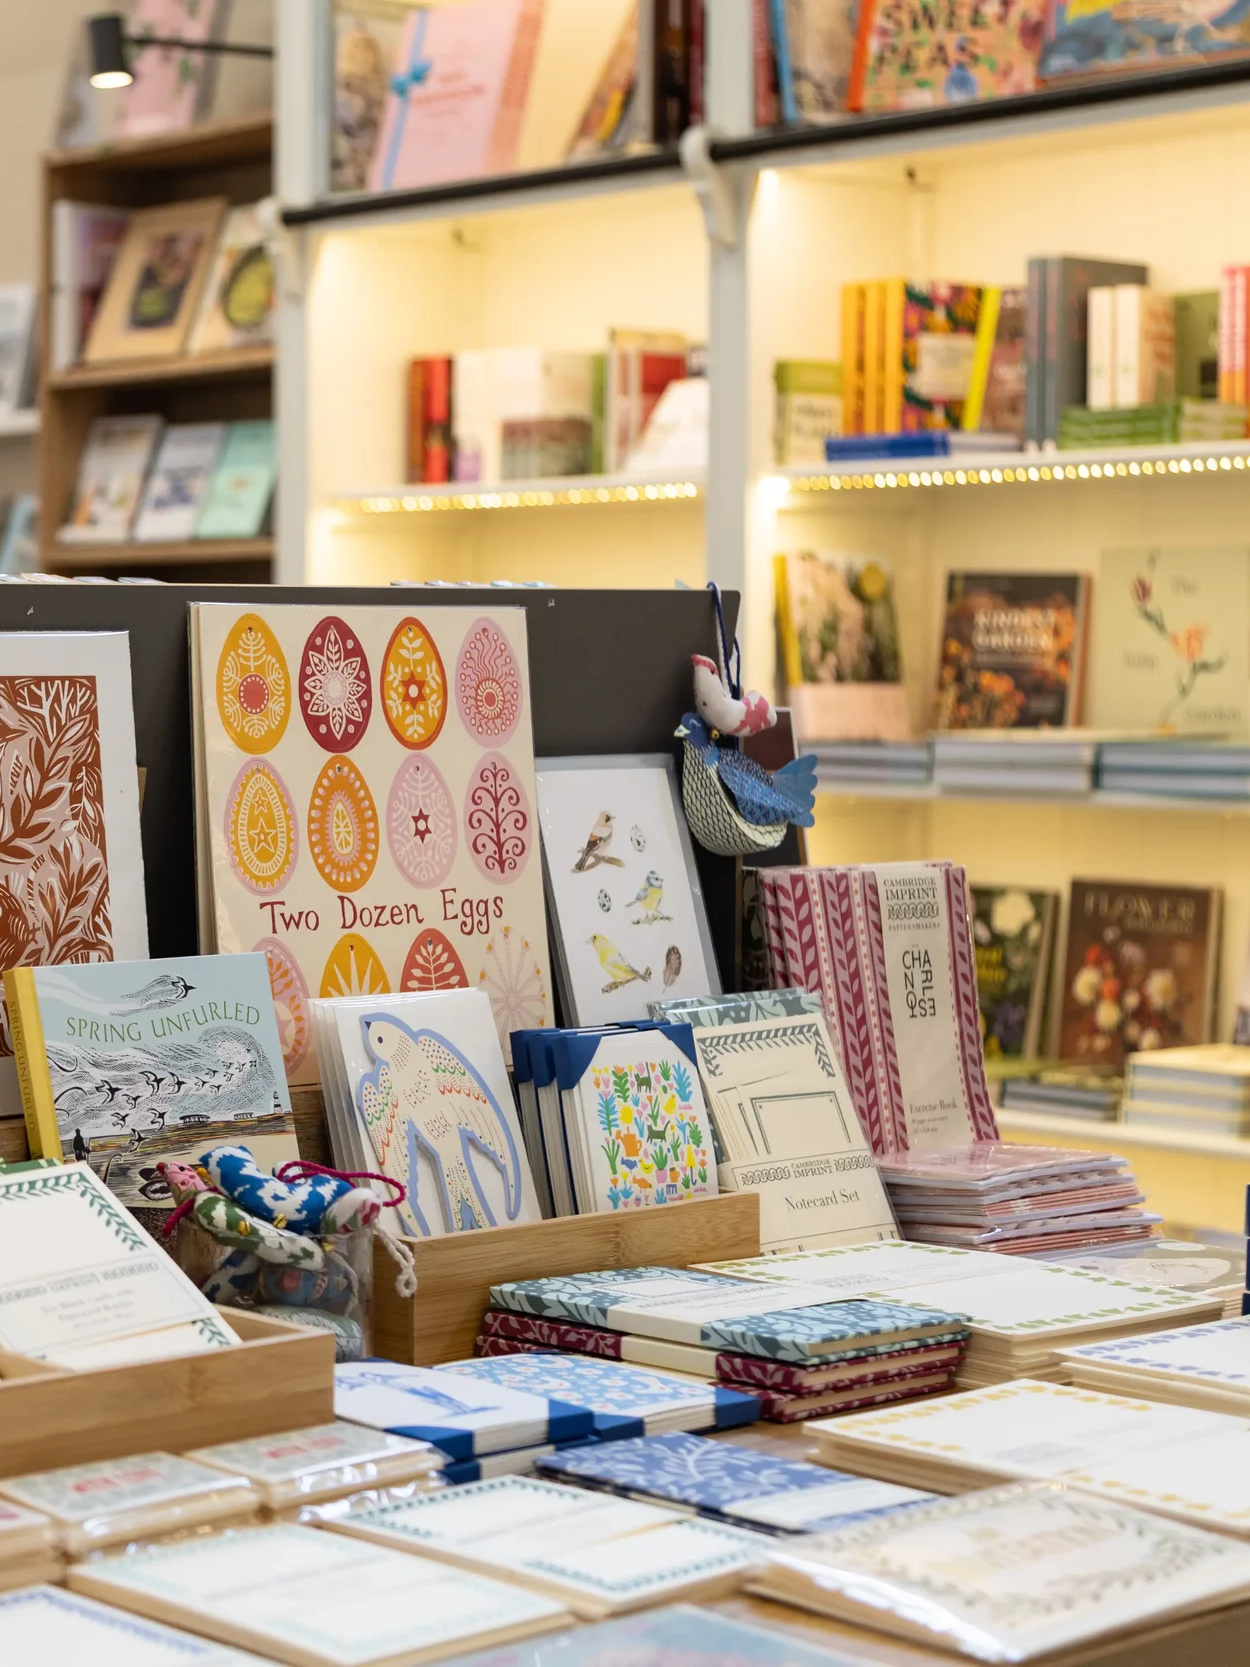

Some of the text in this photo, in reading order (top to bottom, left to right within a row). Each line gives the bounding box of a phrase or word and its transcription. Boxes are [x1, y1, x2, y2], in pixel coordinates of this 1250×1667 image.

[883, 876, 936, 888] CAMBRIDGE
[885, 887, 938, 901] IMPRINT
[259, 888, 504, 936] Two Dozen Eggs
[1084, 892, 1195, 921] FLOWER
[66, 1001, 260, 1043] SPRING UNFURLED
[8, 1000, 36, 1132] SPRING UNFURLED
[939, 1098, 958, 1110] Book
[790, 1158, 831, 1169] CAMBRIDGE
[793, 1166, 835, 1179] IMPRINT
[784, 1188, 861, 1213] Notecard Set
